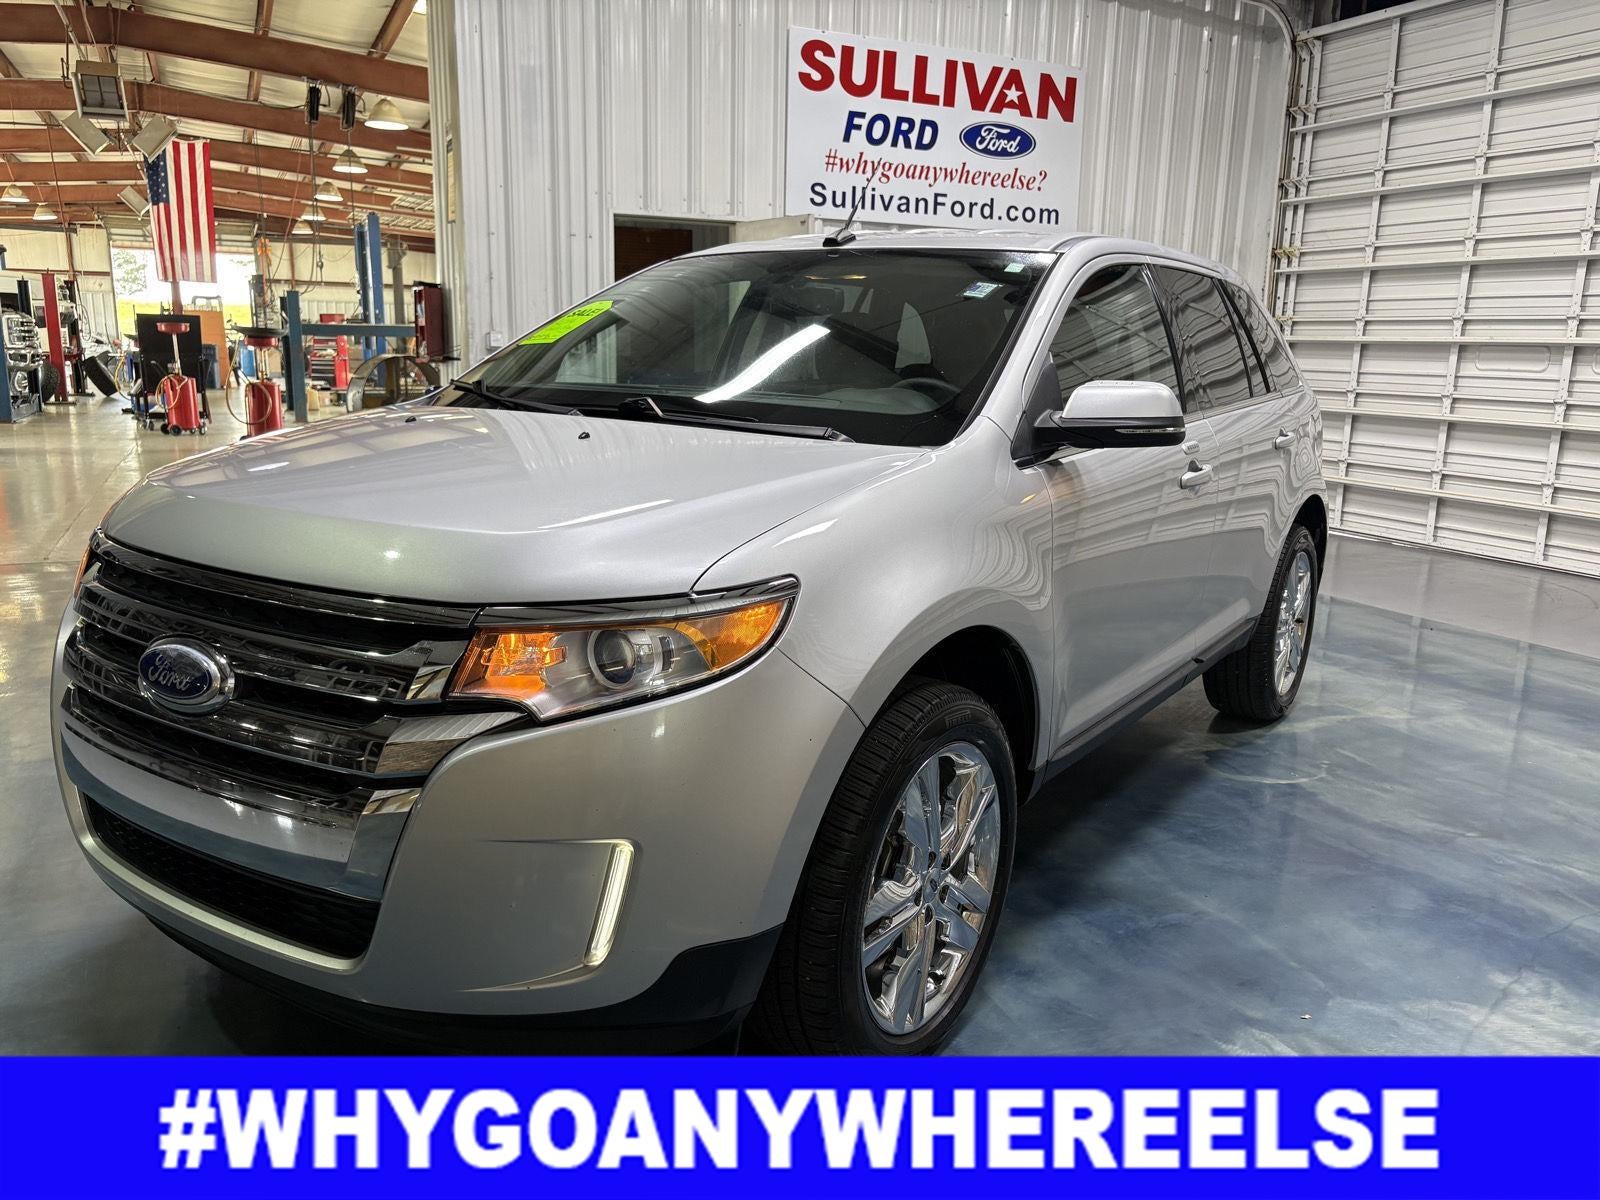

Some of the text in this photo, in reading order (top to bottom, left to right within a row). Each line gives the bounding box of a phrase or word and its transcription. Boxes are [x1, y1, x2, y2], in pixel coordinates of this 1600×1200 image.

[798, 39, 1078, 123] SULLIVAN
[842, 110, 939, 151] FORD
[975, 125, 1022, 154] Ford
[824, 149, 1048, 192] #whygoanywhereelse?
[809, 182, 1060, 225] SullivanFord.com
[148, 654, 192, 691] Ford
